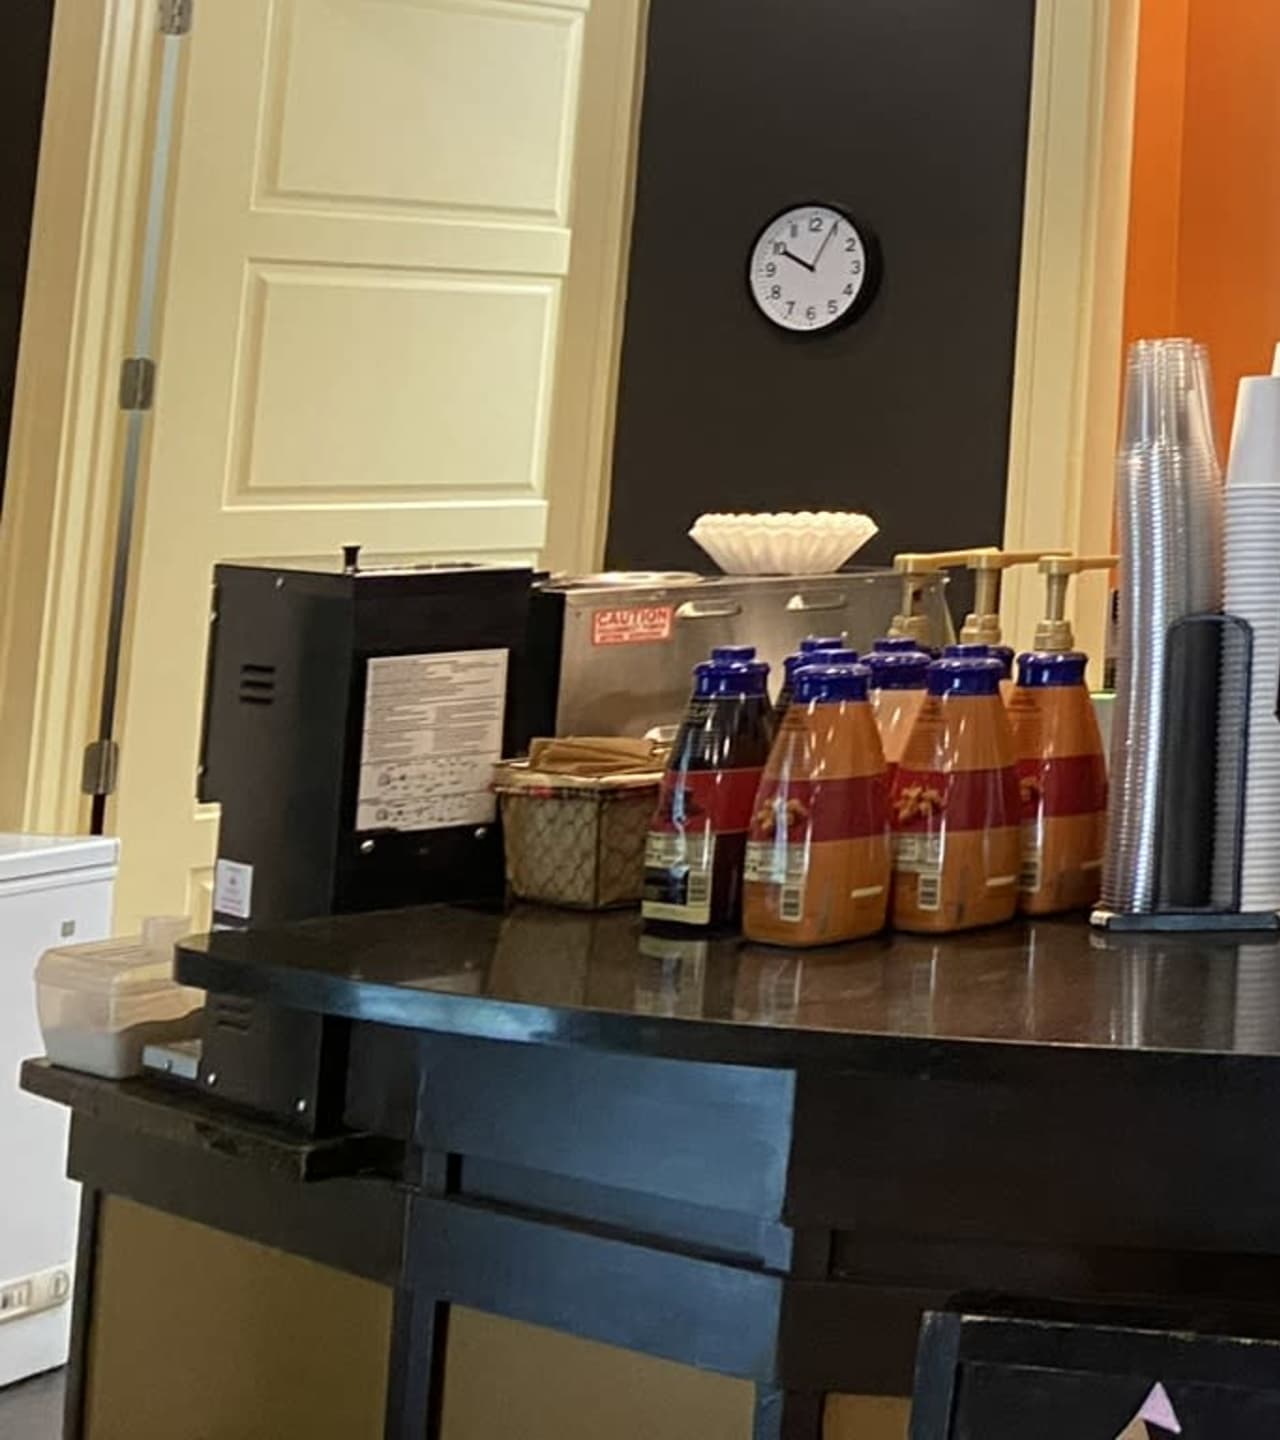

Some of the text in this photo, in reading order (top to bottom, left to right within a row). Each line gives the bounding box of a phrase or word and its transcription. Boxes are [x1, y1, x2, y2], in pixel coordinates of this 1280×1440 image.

[809, 217, 823, 232] 12
[845, 238, 856, 252] 2
[766, 263, 776, 277] 9
[851, 261, 861, 274] 3
[771, 285, 781, 299] 8
[843, 284, 853, 295] 4
[786, 301, 795, 314] 7
[828, 300, 838, 313] 5
[806, 307, 816, 320] 6
[599, 608, 667, 625] CAUTION
